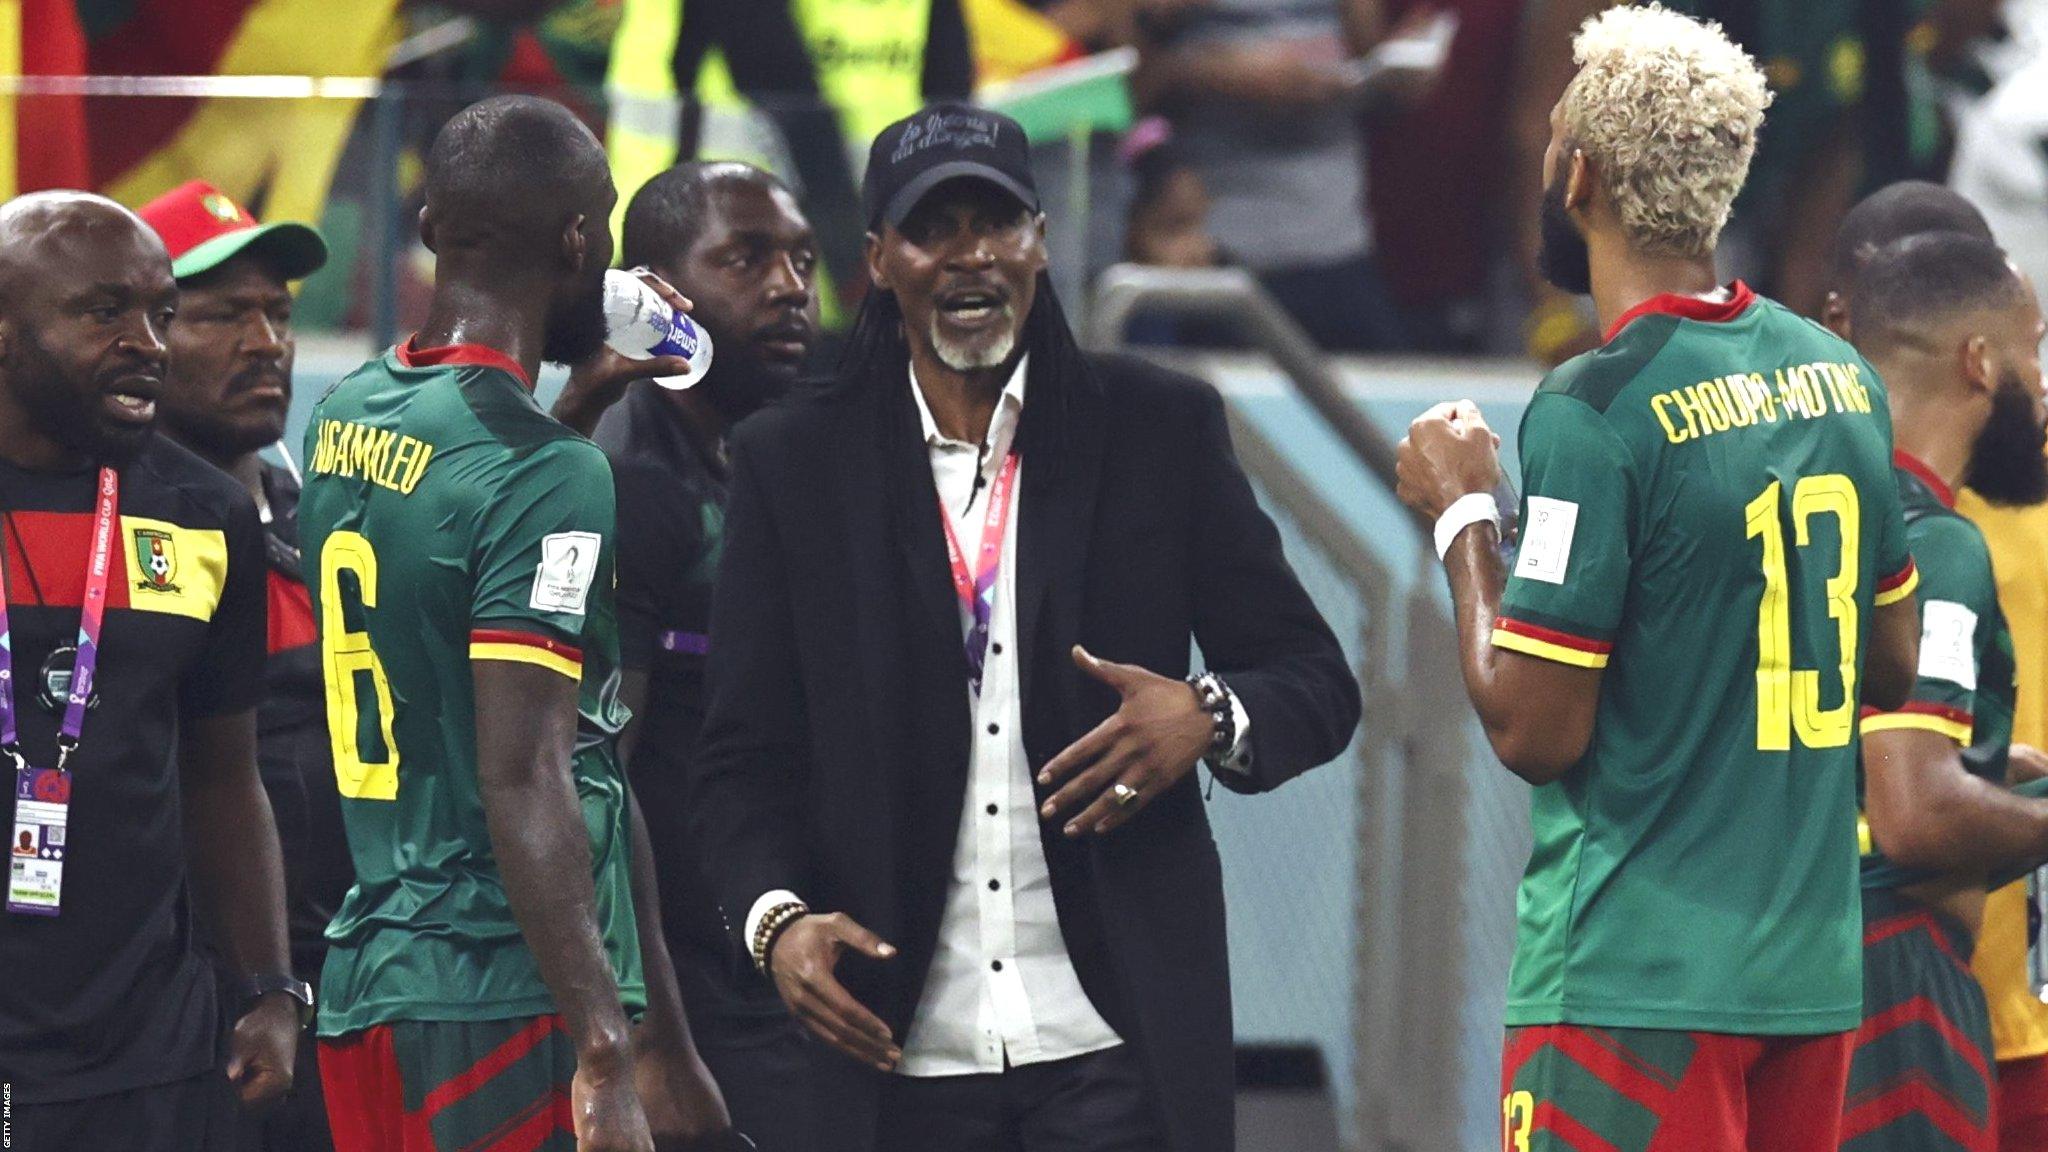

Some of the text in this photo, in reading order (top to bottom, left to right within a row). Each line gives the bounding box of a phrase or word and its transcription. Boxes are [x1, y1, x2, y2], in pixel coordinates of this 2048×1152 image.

[1651, 362, 1871, 444] CHOUPO-MOTING
[97, 517, 111, 552] WORLD
[101, 498, 112, 517] CUP
[1744, 473, 1860, 751] 13
[320, 530, 400, 801] 6
[1503, 1090, 1534, 1152] 13
